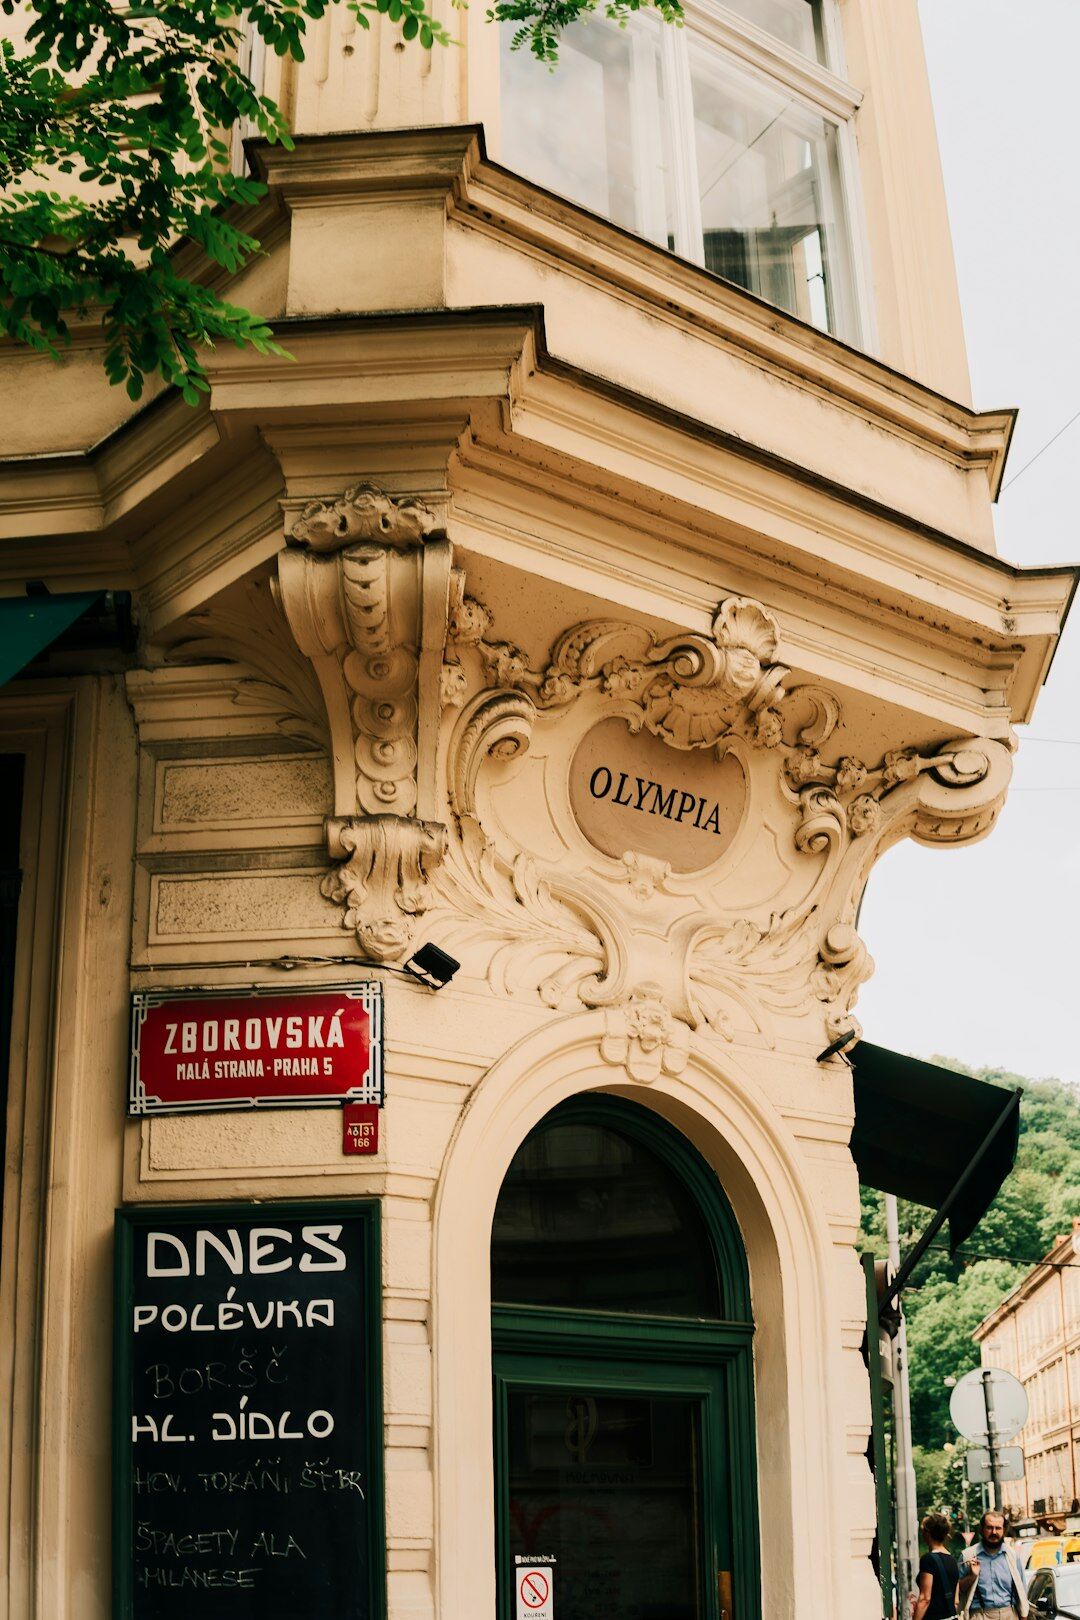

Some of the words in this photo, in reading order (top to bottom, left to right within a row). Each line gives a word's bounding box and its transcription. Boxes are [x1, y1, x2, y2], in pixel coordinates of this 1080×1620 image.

[590, 766, 721, 834] OLYMPIA
[164, 1008, 345, 1055] ZBOROVSKÁ
[176, 1058, 210, 1081] MALÁ
[323, 1057, 333, 1076] 5
[353, 1137, 370, 1148] 166
[147, 1225, 347, 1277] DNES
[133, 1286, 335, 1333] POLÉVKA
[131, 1414, 195, 1442] HL.
[211, 1395, 335, 1441] JÍDLO
[250, 1531, 307, 1559] ALA
[143, 1566, 263, 1588] MILANESE
